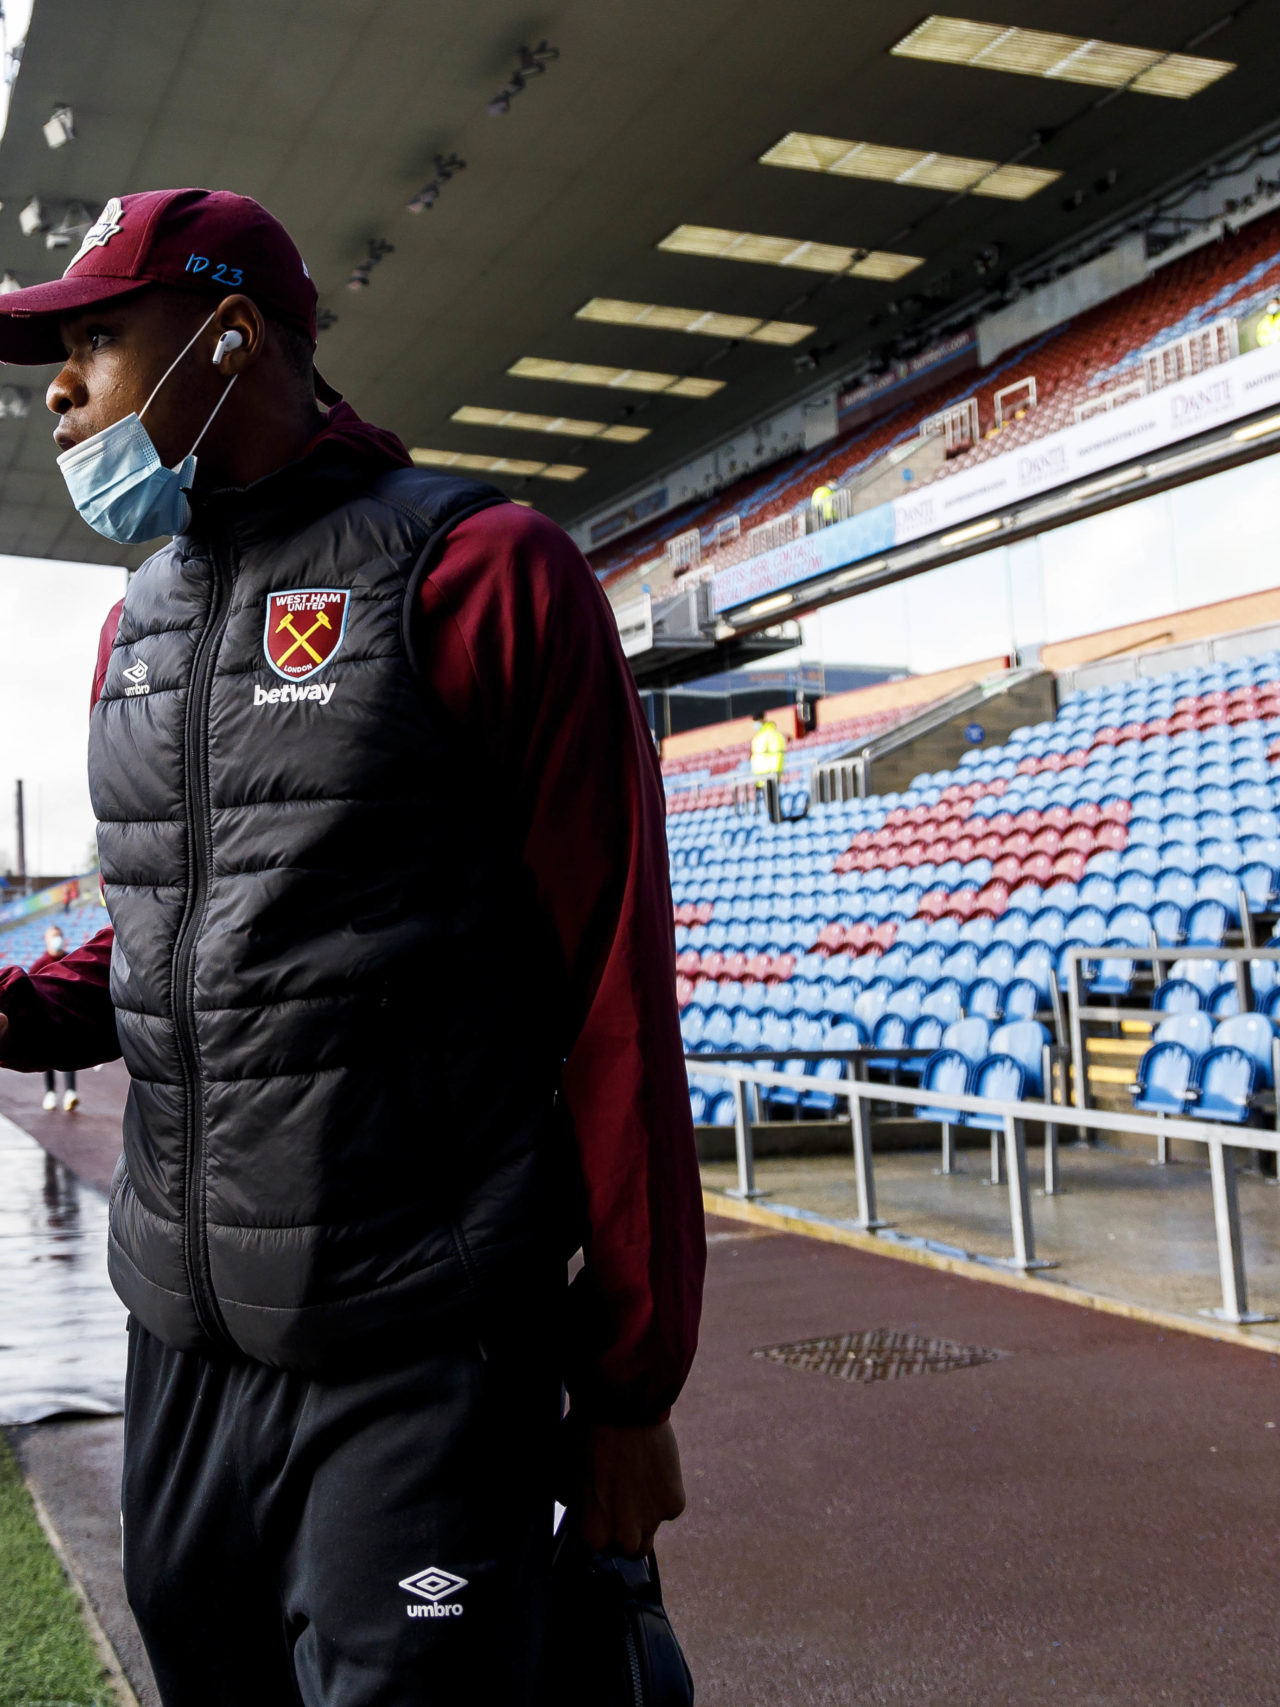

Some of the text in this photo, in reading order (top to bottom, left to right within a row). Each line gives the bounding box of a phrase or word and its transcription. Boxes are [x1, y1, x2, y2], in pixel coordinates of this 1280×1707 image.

[185, 253, 244, 286] ID 23
[276, 593, 341, 606] WEST HAM
[287, 602, 325, 612] UNITED
[283, 663, 313, 673] LONDON
[124, 683, 150, 697] umbro
[253, 682, 337, 706] betway
[407, 1602, 464, 1617] umbro
